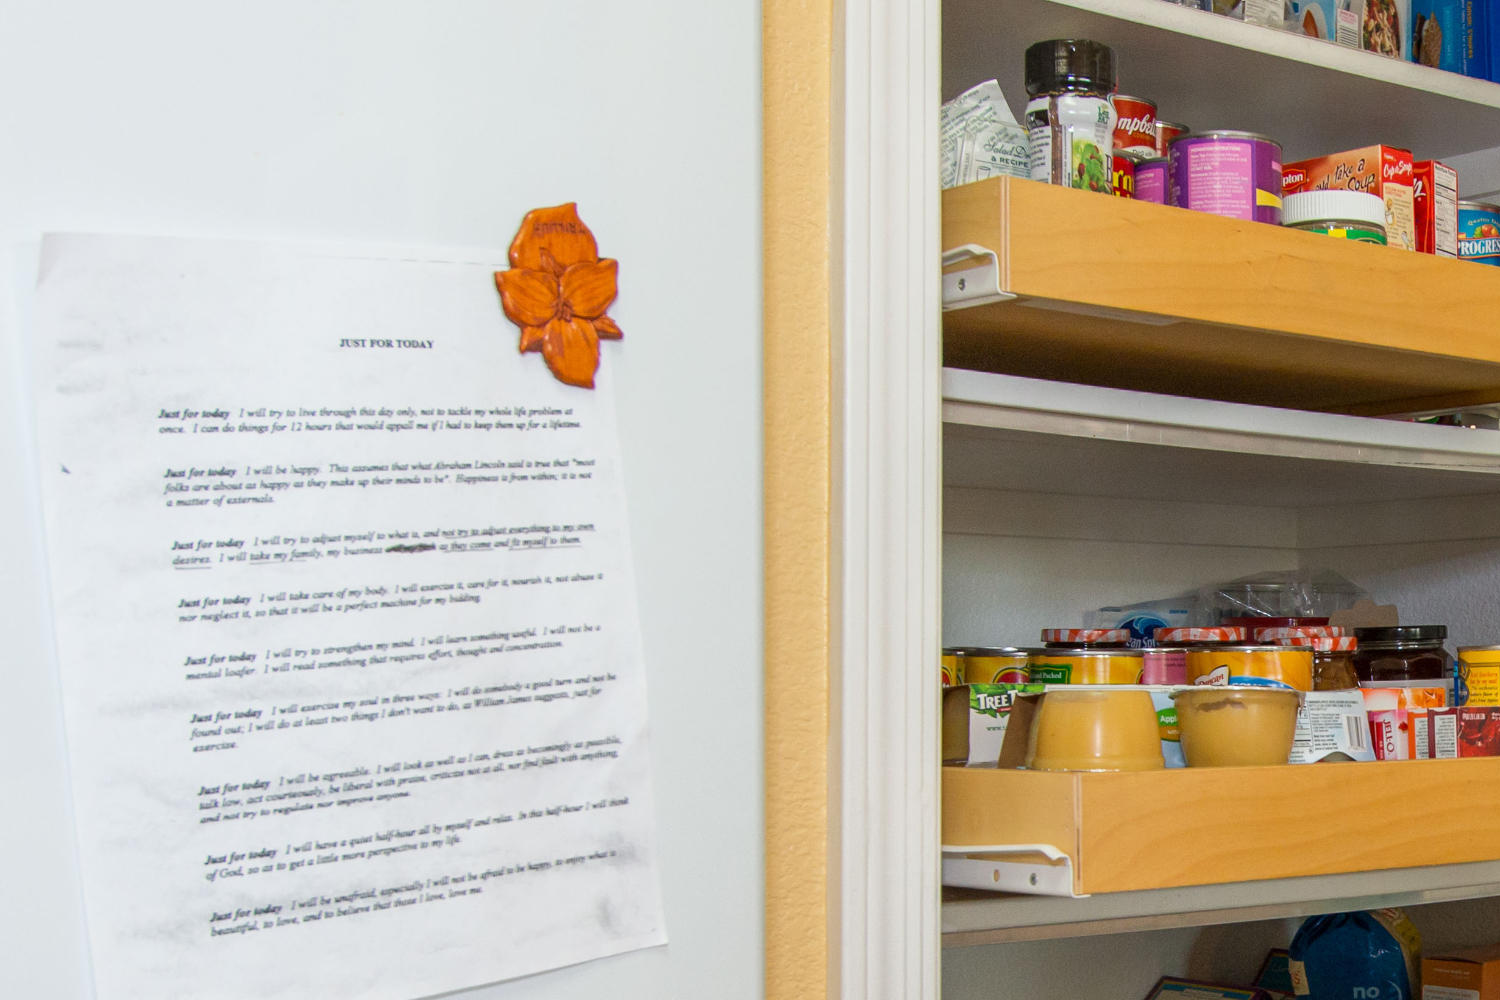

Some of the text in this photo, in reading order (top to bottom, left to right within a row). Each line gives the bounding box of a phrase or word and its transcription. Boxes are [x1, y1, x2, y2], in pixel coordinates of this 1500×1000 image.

[1282, 172, 1304, 187] pton
[340, 337, 434, 350] JUST FOR TODAY
[978, 693, 1009, 711] TREE
[1160, 714, 1178, 724] Appl
[1353, 986, 1379, 1000] no
